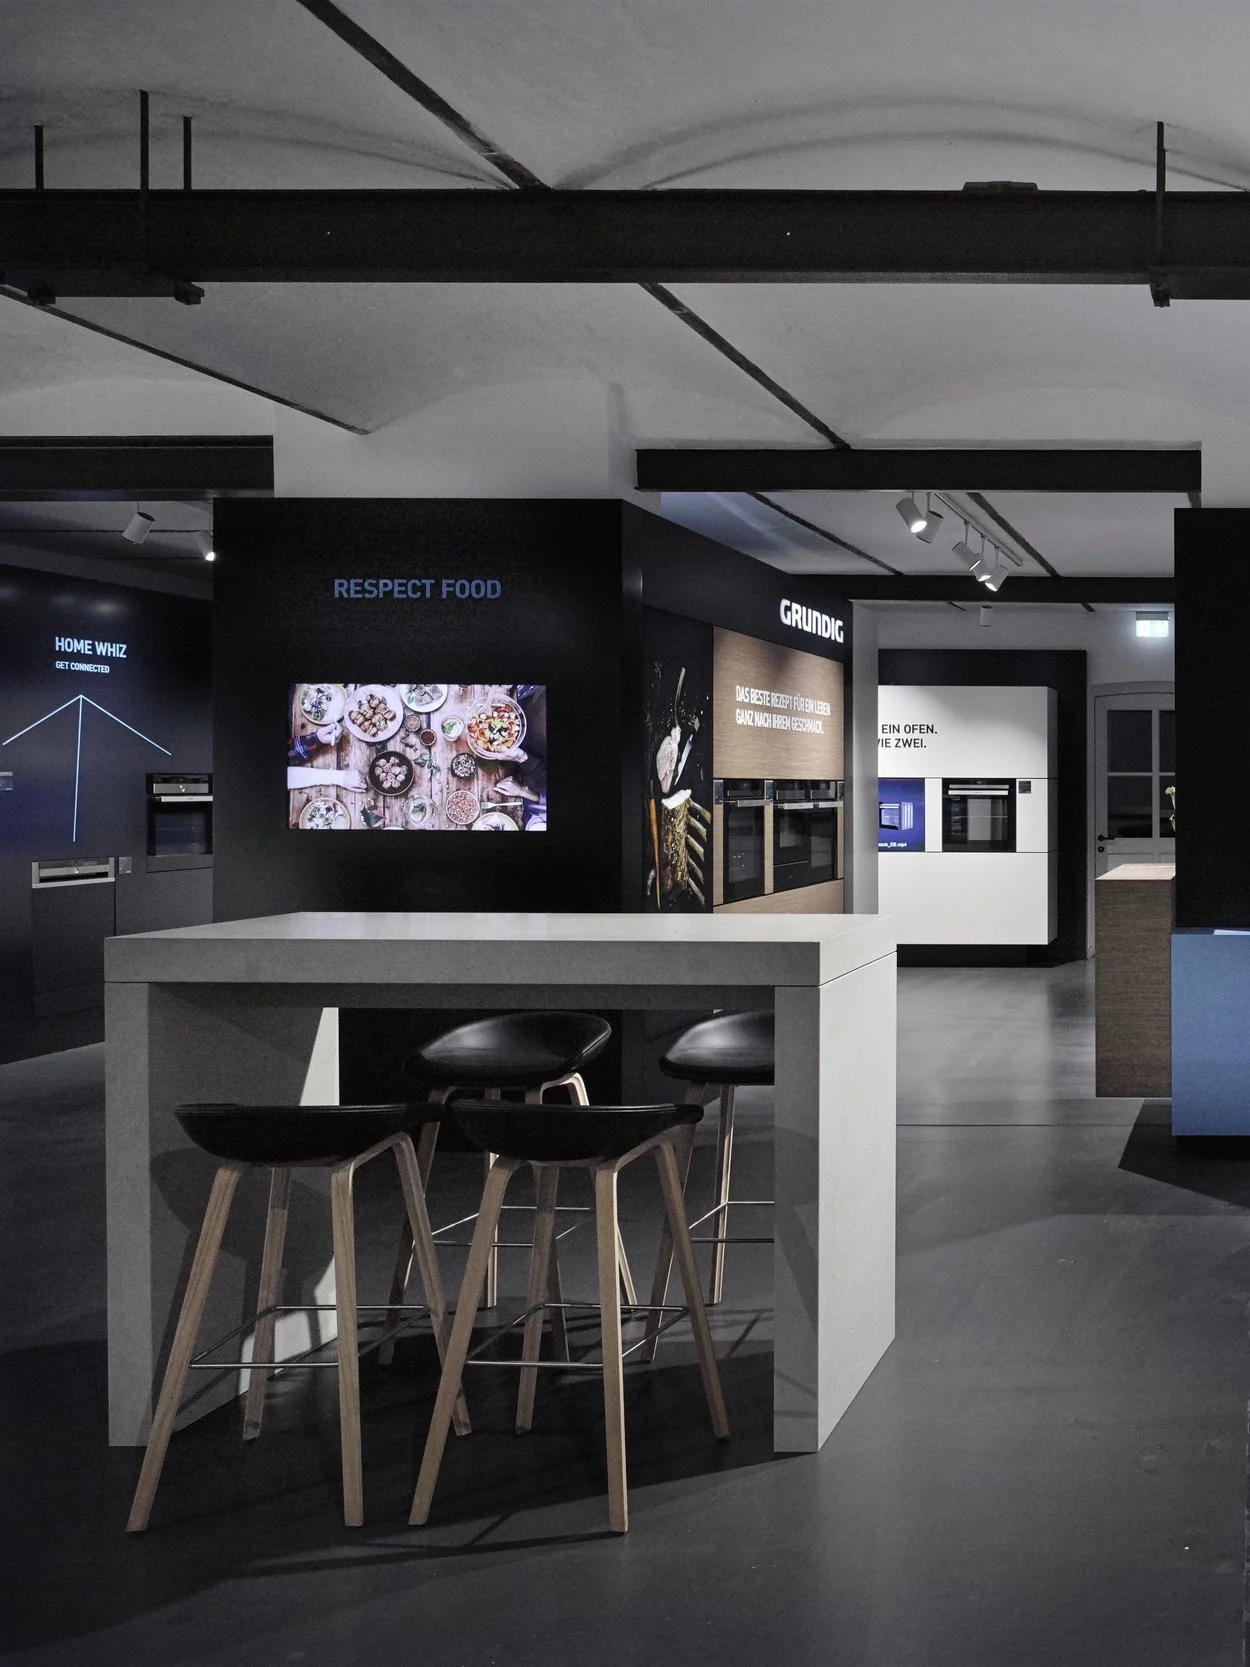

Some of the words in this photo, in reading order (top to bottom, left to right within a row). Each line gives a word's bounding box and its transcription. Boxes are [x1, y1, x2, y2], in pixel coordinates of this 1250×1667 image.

[334, 578, 435, 599] RESPECT
[441, 579, 502, 599] FOOD
[780, 598, 844, 644] GRUNDIG
[55, 636, 93, 655] HOME
[94, 640, 127, 659] WHIZ
[55, 661, 69, 670] GET
[70, 662, 110, 674] CONNECTED
[736, 685, 750, 703] DAS
[750, 688, 771, 706] BESTE
[771, 692, 793, 710] REZEPT
[793, 692, 805, 712] FÜR
[805, 699, 814, 714] EIN
[814, 701, 831, 716] LEBEN
[736, 708, 754, 726] GANZ
[754, 711, 772, 728] NACH
[772, 714, 791, 730] IHREM
[791, 717, 824, 735] GESCHMACK.
[881, 724, 900, 734] EIN
[903, 724, 938, 734] OFEN.
[877, 738, 891, 748] IE
[894, 738, 927, 748] ZWEI.
